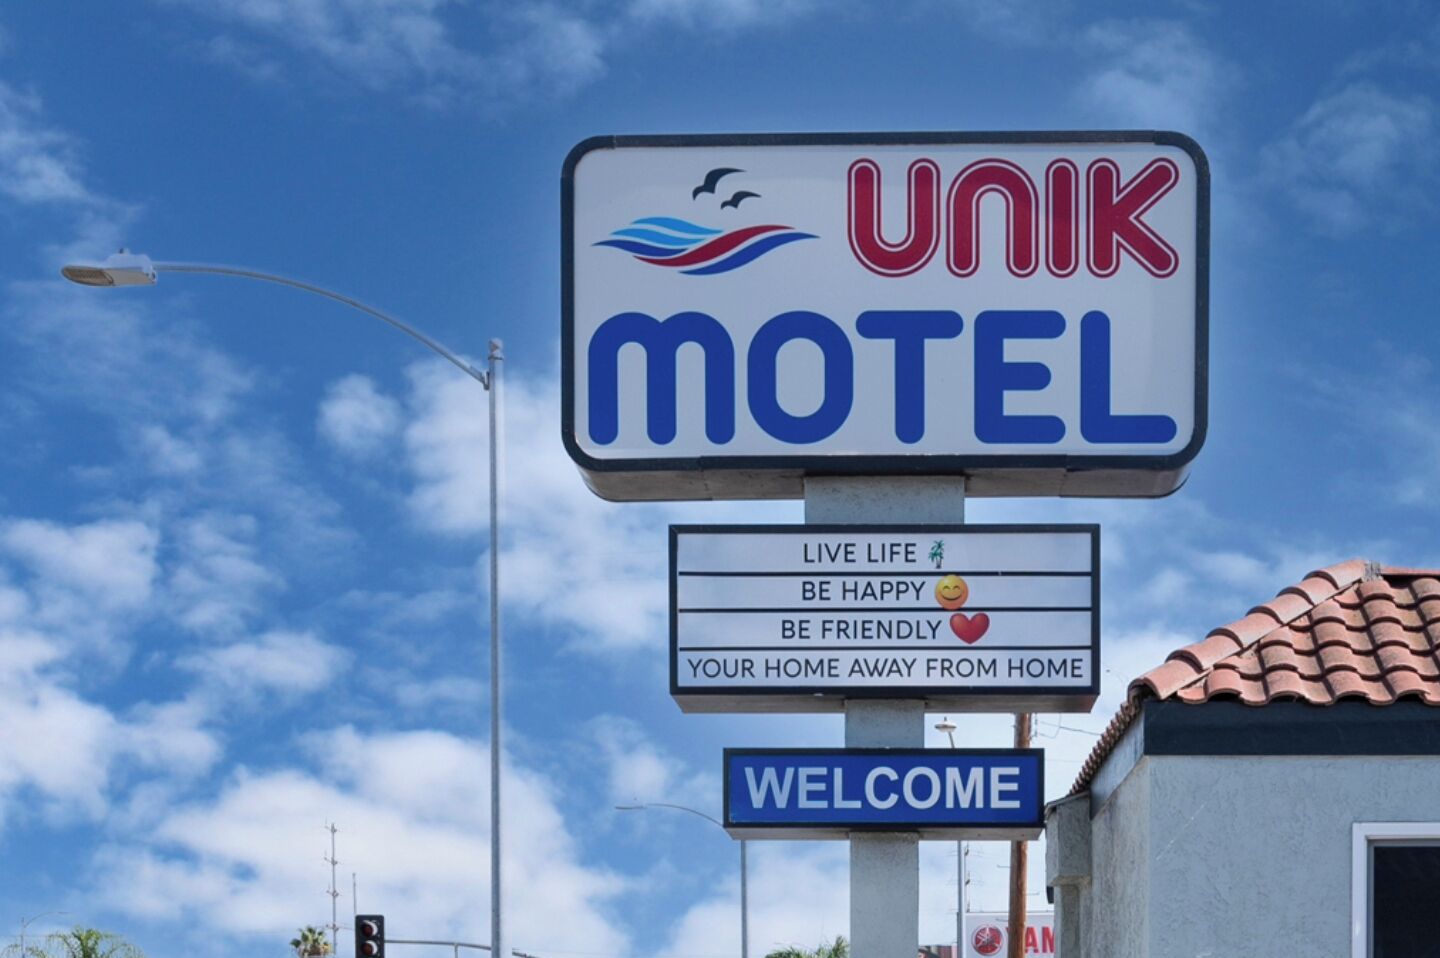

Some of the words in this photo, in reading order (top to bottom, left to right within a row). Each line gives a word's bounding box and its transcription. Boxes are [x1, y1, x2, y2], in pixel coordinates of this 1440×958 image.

[848, 158, 1180, 279] UNIK
[587, 309, 1178, 446] MOTEL
[803, 542, 857, 564] LIVE
[867, 542, 917, 564] LIFE
[801, 580, 831, 601] BE
[842, 580, 926, 601] HAPPY
[781, 618, 814, 640] BE
[822, 618, 942, 640] FRIENDLY
[687, 657, 755, 679] YOUR
[765, 657, 840, 679] HOME
[848, 657, 917, 679] AWAY
[926, 657, 998, 679] FROM
[1007, 657, 1084, 679] HOME
[744, 765, 1022, 810] WELCOME
